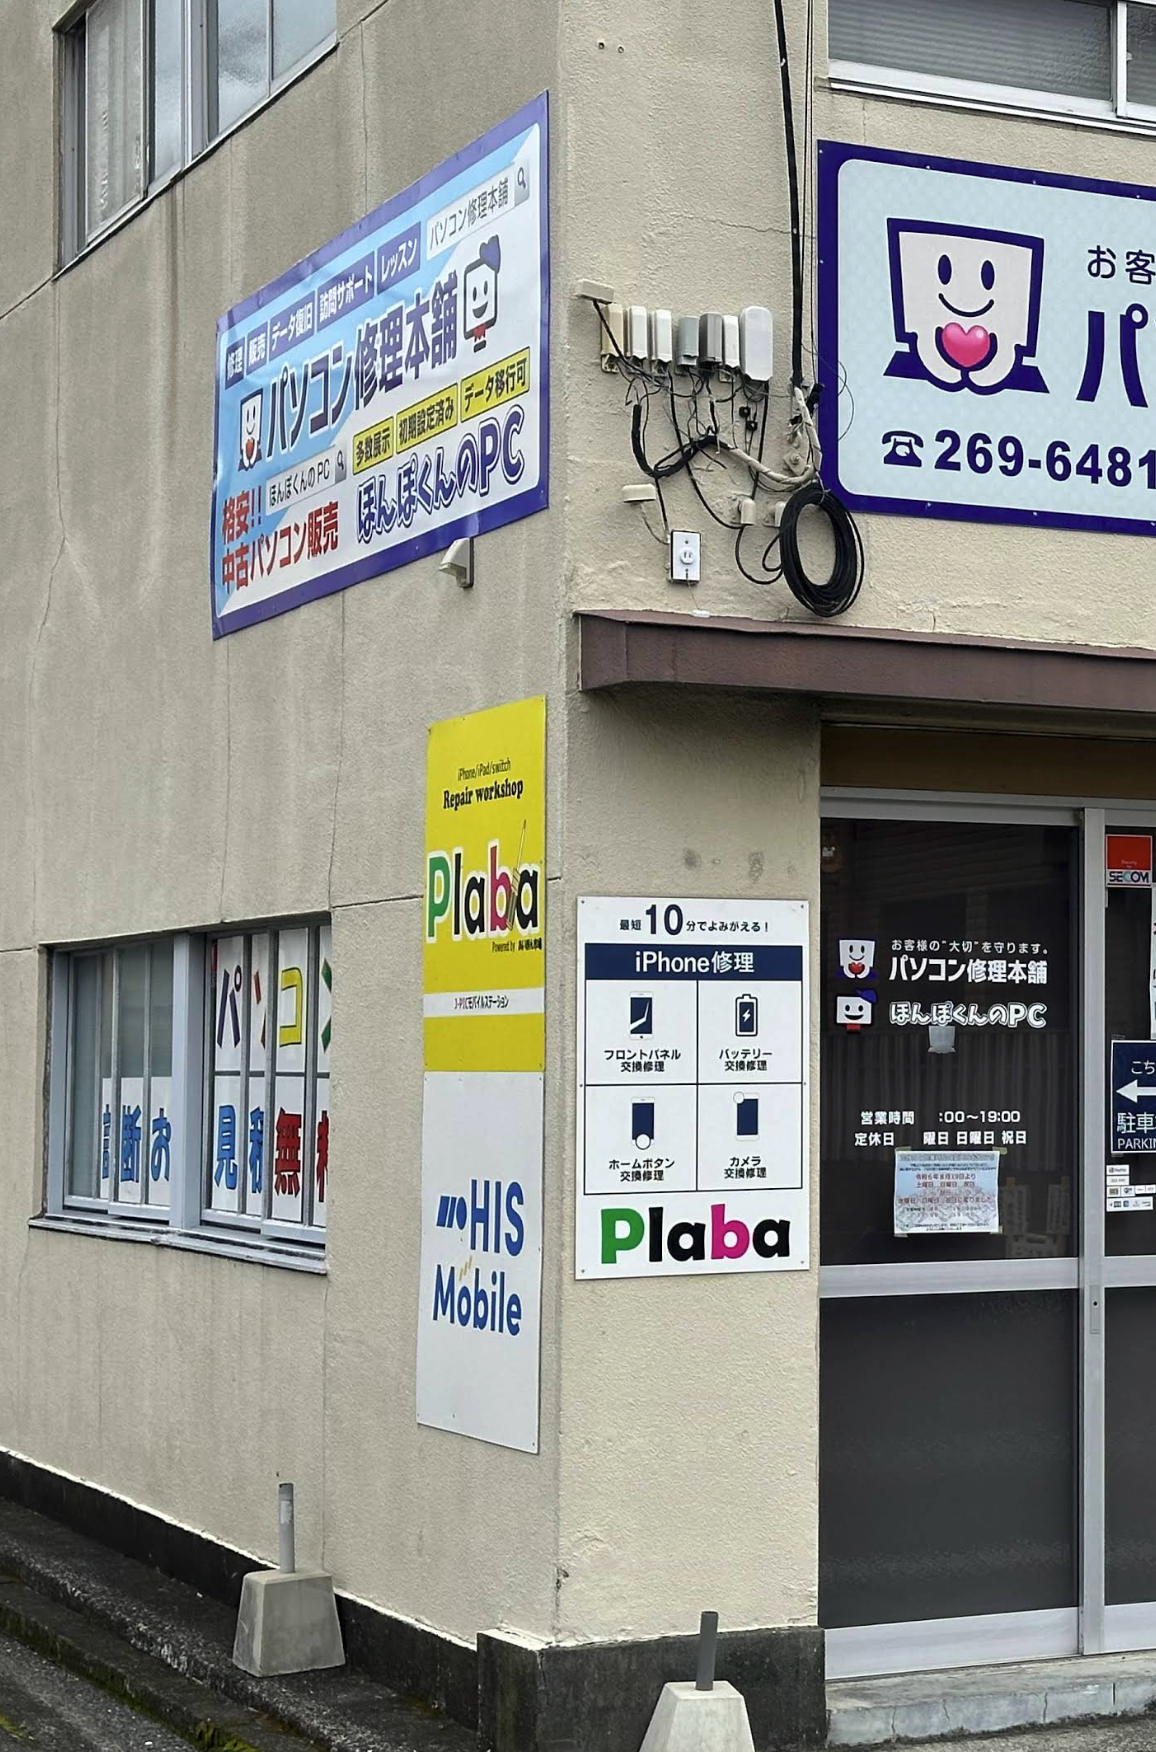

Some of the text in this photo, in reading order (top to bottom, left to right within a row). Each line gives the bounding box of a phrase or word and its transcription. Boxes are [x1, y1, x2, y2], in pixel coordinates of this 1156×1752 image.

[430, 178, 509, 250] パソコン修理本舗
[249, 333, 266, 364] 販売
[270, 301, 313, 351] データ復旧
[319, 267, 372, 323] 訪問サポート
[381, 238, 417, 279] レッスン
[266, 269, 458, 458] パソコン修理本舗
[356, 358, 527, 467] 多数展示 初期設定済み データ移行可
[358, 404, 525, 543] ほんぽくんのPC
[934, 430, 1156, 489] 269-6481
[222, 501, 339, 594] 中古パソコン販売
[443, 778, 523, 811] Repair workshop
[428, 846, 538, 938] Plaba
[1109, 871, 1149, 883] SECOM
[635, 951, 755, 973] iPhone修理
[889, 954, 1047, 984] パソコン修理本舗
[604, 1049, 681, 1060] フロントパネル
[621, 1061, 665, 1073] 交換修理
[719, 1049, 772, 1060] バッテリー
[724, 1060, 767, 1072] 交換修理
[861, 1111, 915, 1125] 営業時間
[854, 1130, 1027, 1146] 定休日 曜日 日曜日 祝日
[608, 1158, 675, 1170] ホームボタン
[620, 1170, 664, 1182] 交換修理
[724, 1167, 767, 1179] 交換修理
[730, 1156, 761, 1167] カメラ
[470, 1179, 524, 1256] HIS
[601, 1203, 790, 1264] Plaba
[433, 1263, 522, 1336] Mobile
